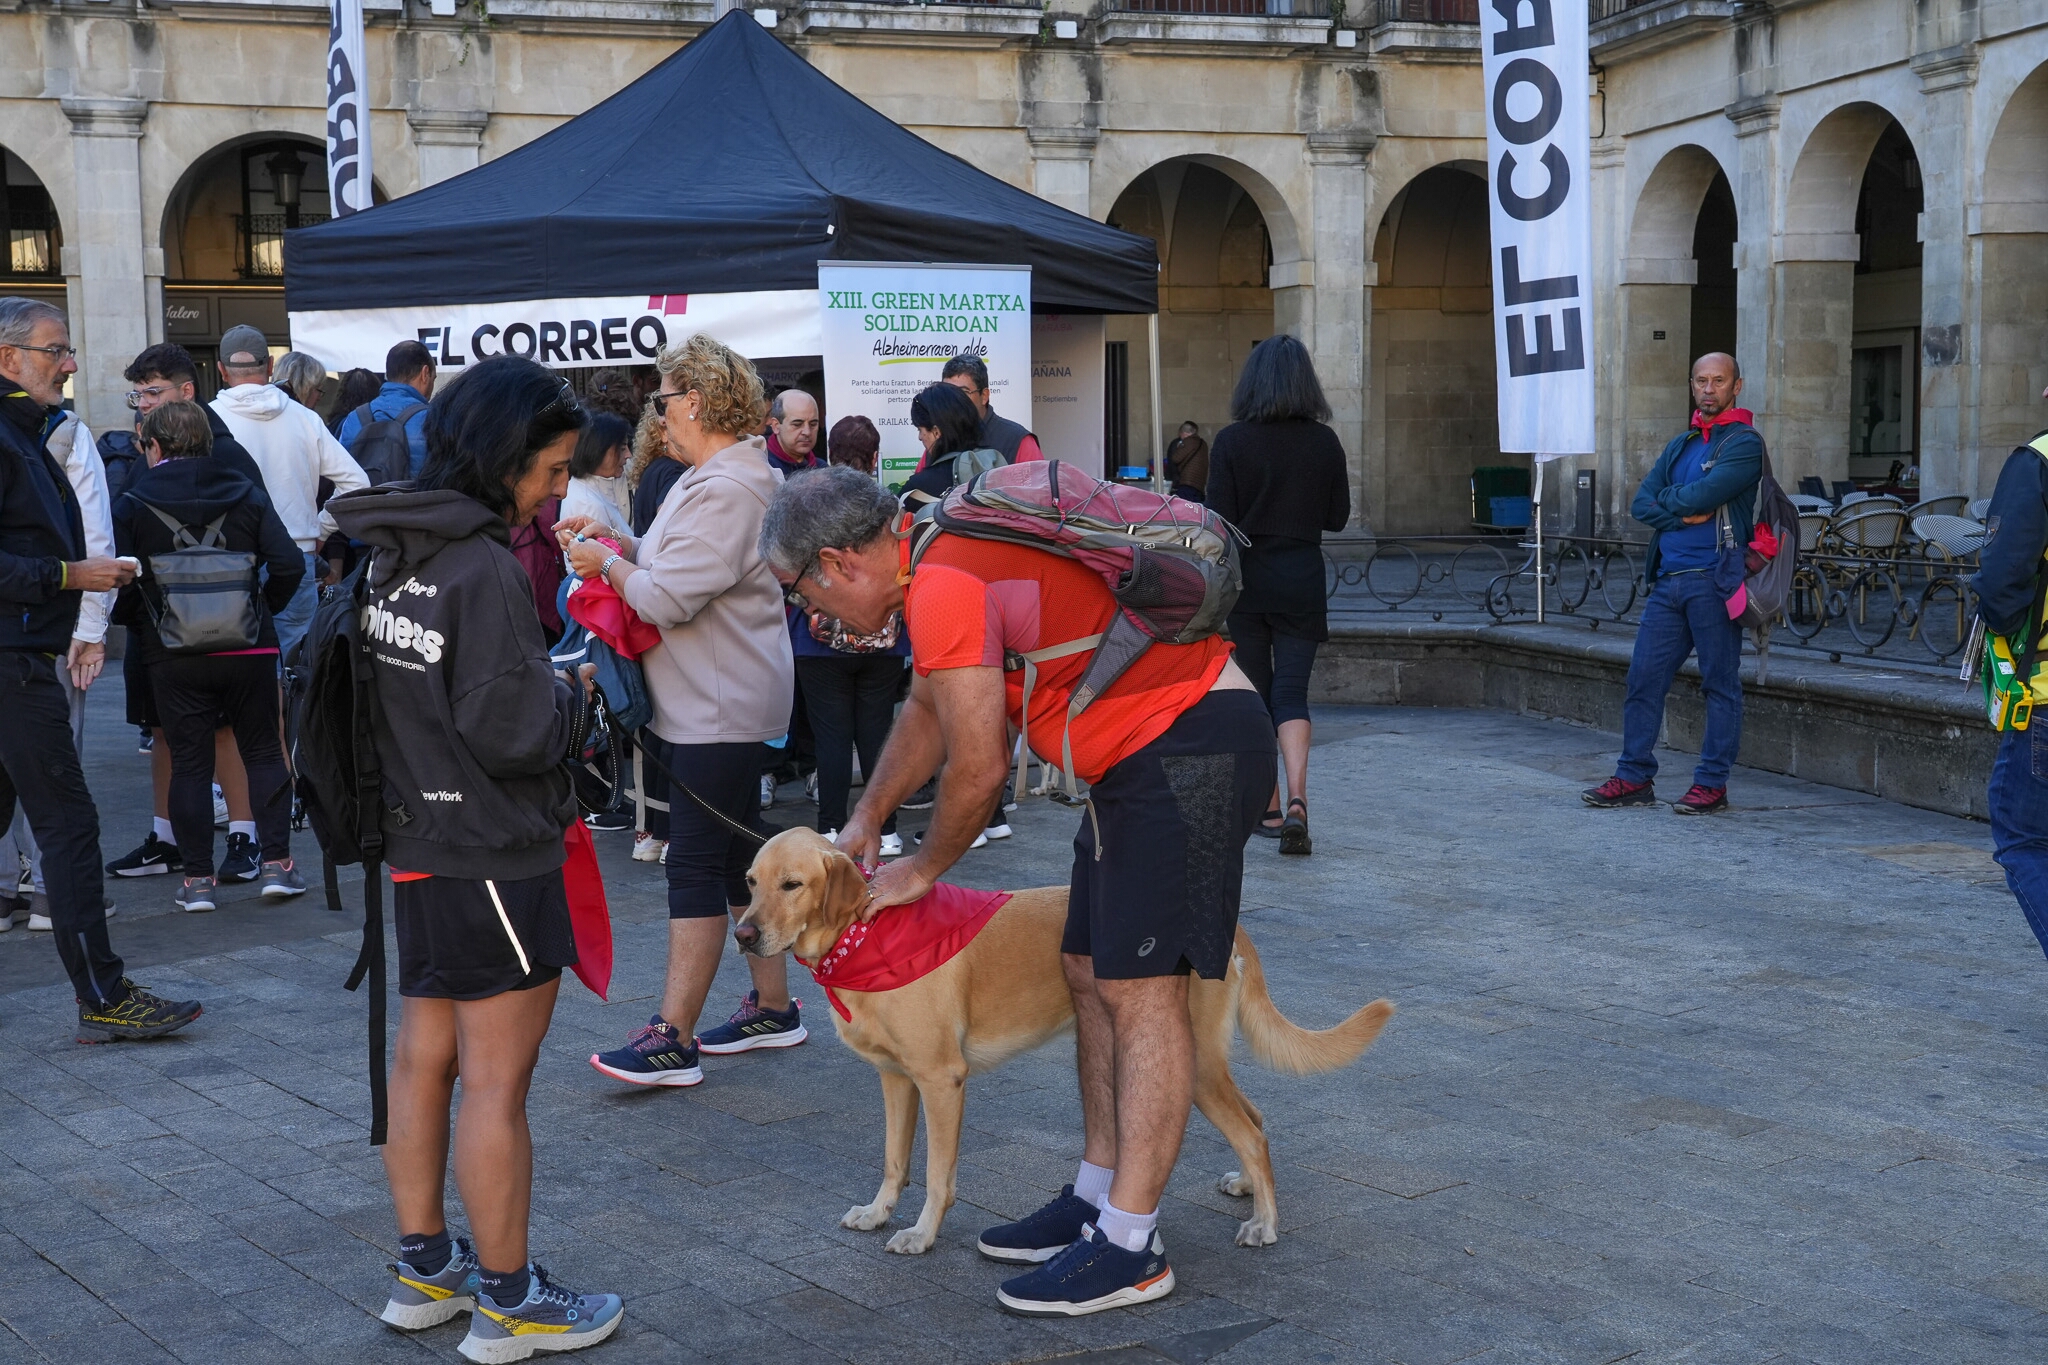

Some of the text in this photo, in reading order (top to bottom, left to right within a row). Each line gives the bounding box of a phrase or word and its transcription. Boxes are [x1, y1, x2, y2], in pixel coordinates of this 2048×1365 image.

[828, 291, 1026, 312] XIII. GREEN MARTXA
[1501, 245, 1585, 378] EL
[864, 314, 999, 333] SOLIDARIOAN
[471, 315, 668, 363] CORREO
[872, 336, 988, 357] Alzheimerraren alde
[851, 379, 870, 387] Parte
[871, 379, 890, 387] hartu
[891, 379, 916, 387] Eraztun
[878, 418, 909, 426] IRAILAK
[92, 1015, 128, 1025] SPORTIVA
